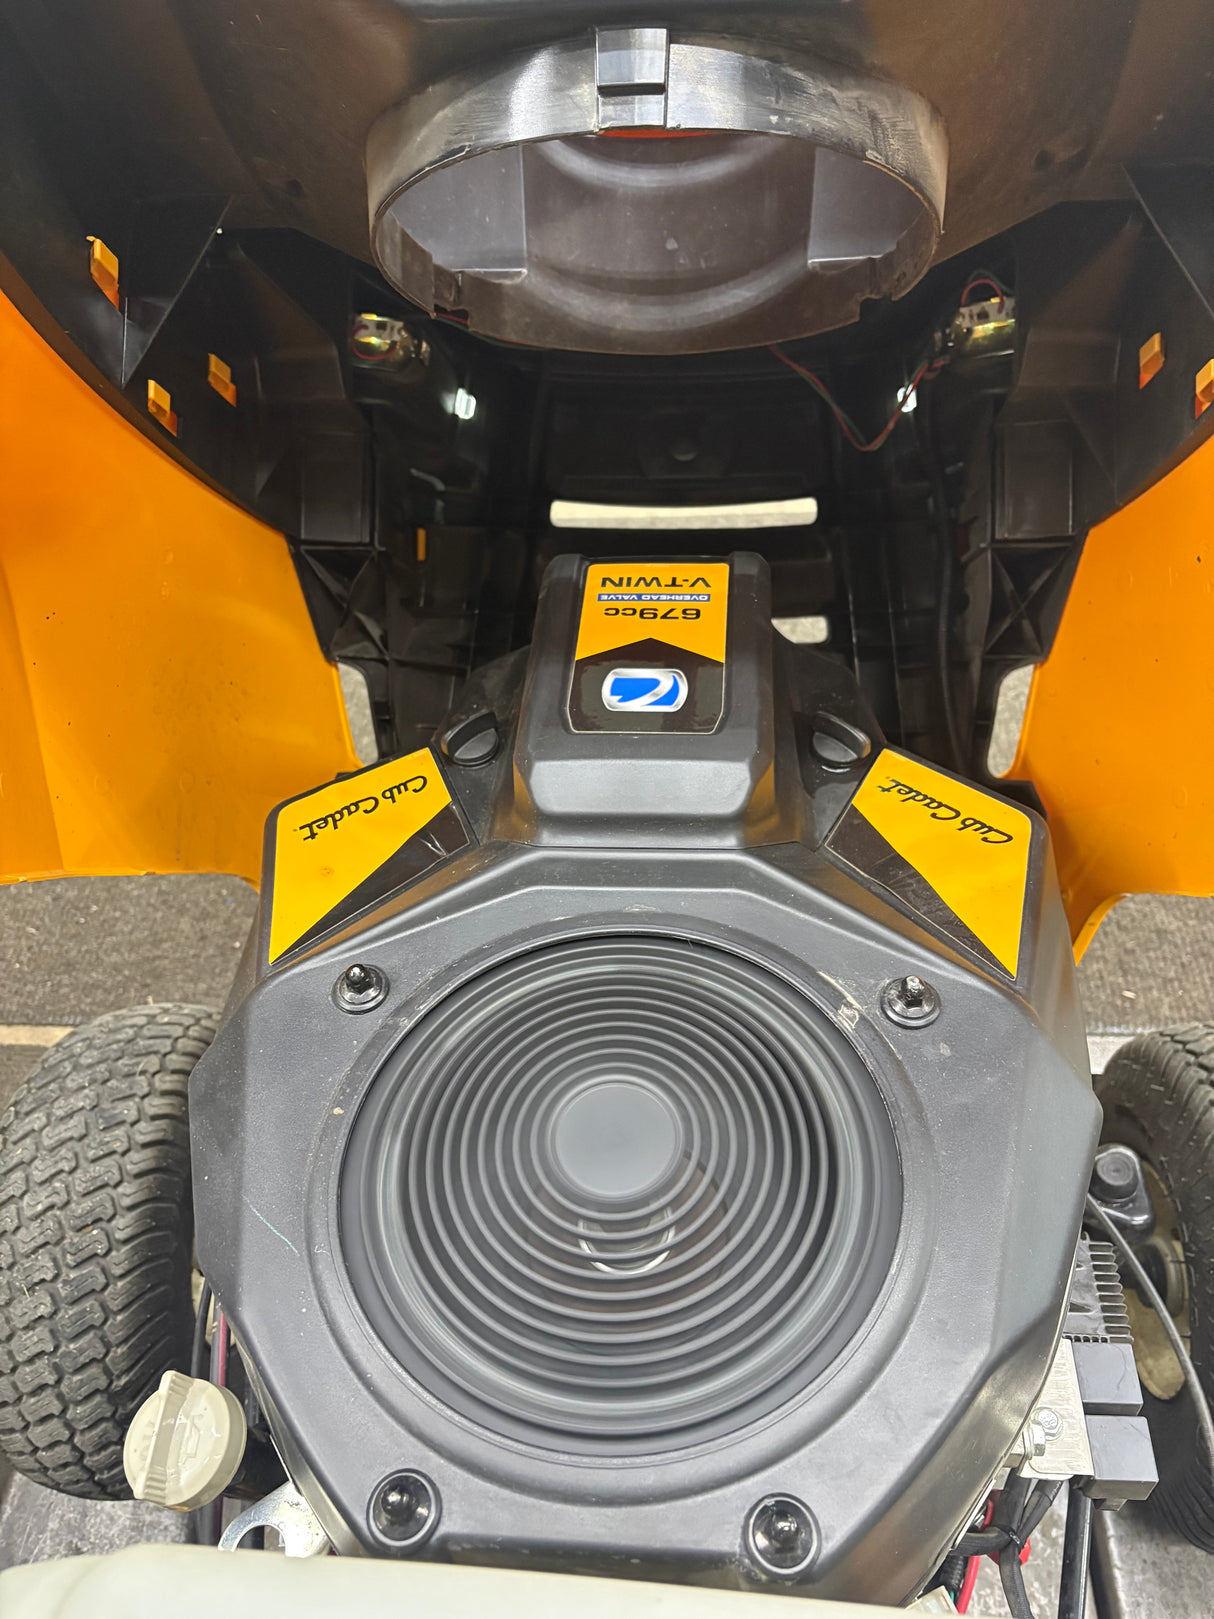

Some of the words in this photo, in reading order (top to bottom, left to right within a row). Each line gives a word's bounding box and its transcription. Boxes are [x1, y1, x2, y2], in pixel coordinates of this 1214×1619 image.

[601, 577, 711, 588] V-TWIN
[604, 607, 701, 619] 679cc
[381, 775, 427, 804] Cub
[956, 817, 1013, 844] Cub
